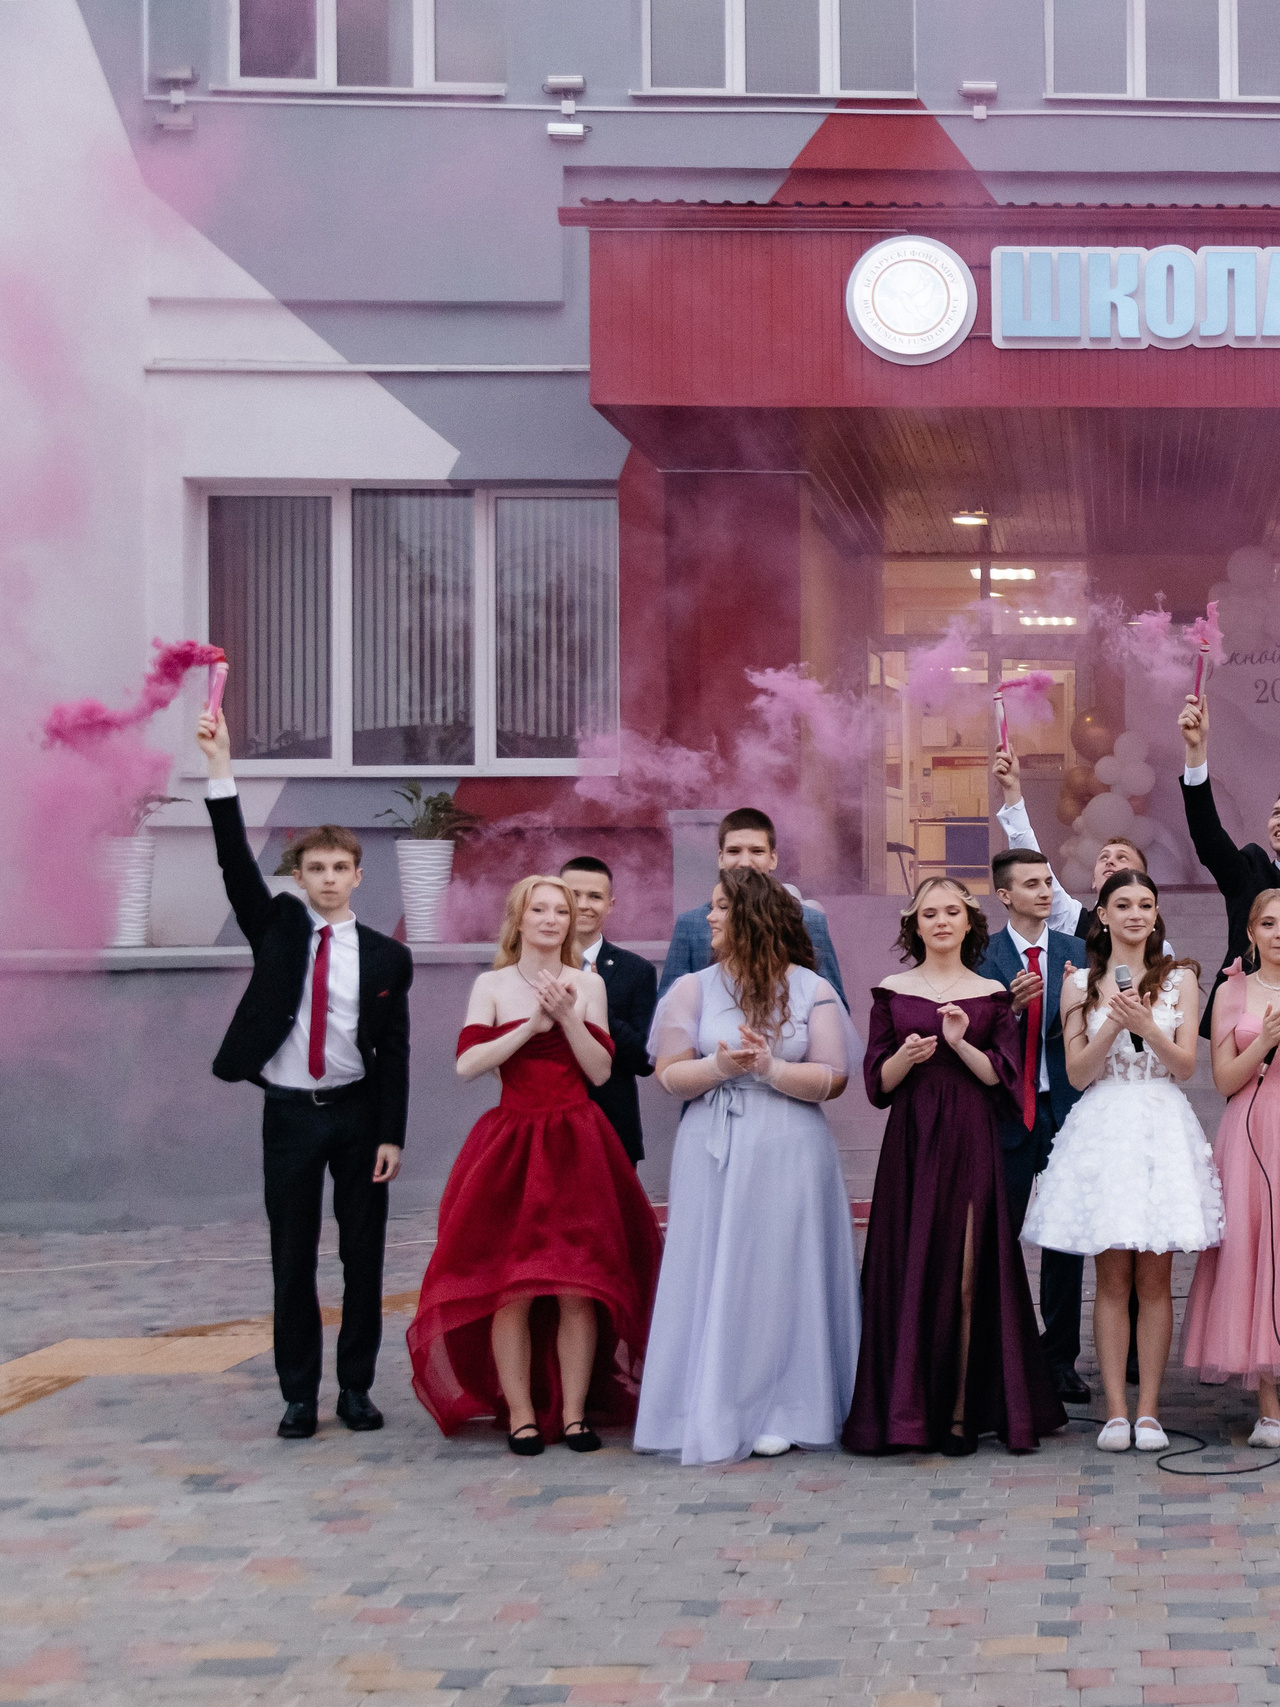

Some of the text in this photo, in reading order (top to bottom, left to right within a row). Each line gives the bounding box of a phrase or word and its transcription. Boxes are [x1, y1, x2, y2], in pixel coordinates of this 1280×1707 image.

[863, 299, 904, 345] BELARUSIAN
[907, 333, 934, 346] FUND
[945, 299, 960, 326] PEACE
